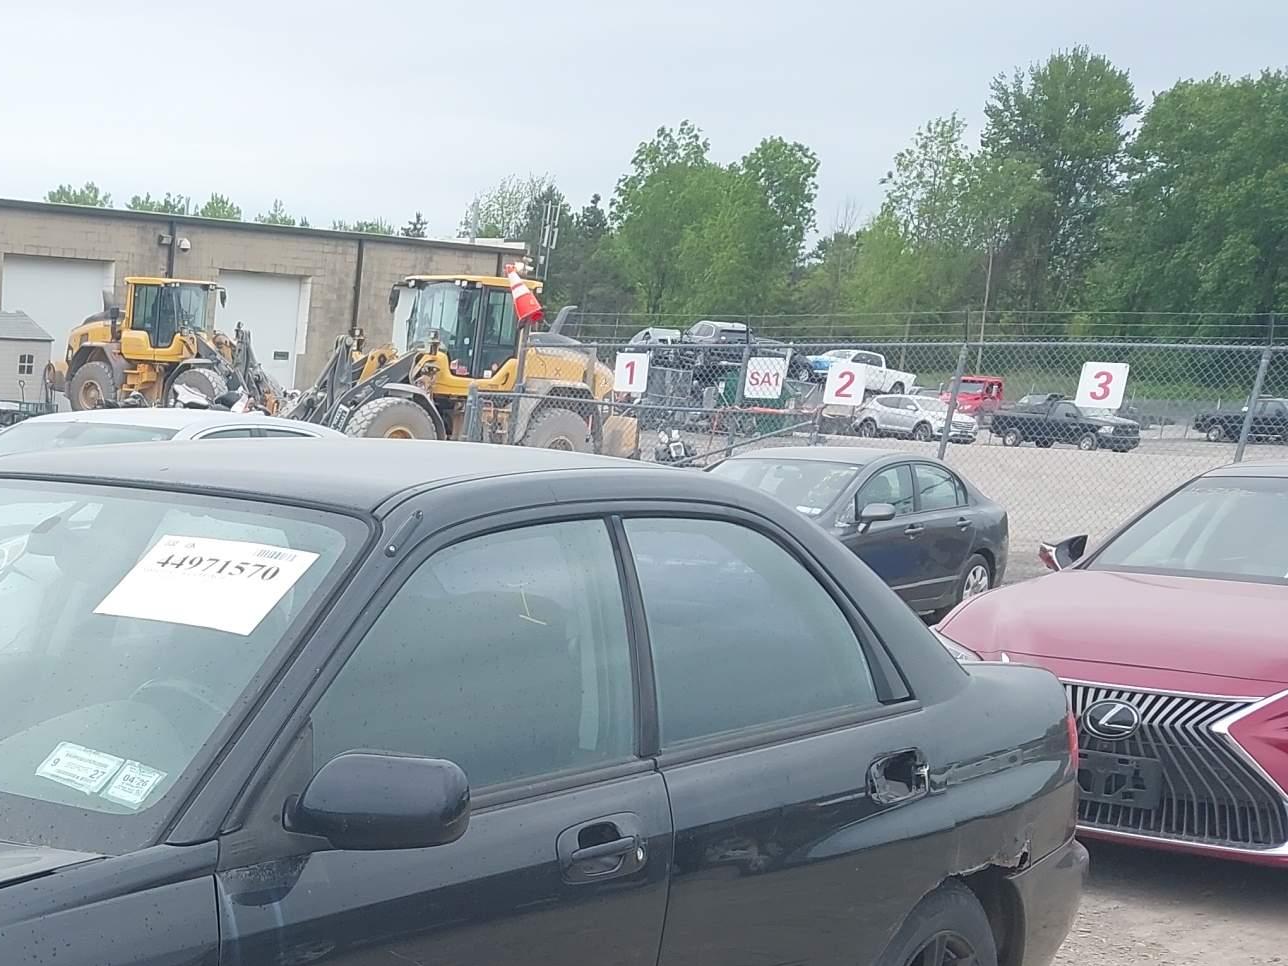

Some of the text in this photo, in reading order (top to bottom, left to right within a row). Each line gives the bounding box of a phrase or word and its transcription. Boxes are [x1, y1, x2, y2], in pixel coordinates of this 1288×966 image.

[624, 360, 636, 386] 1
[748, 371, 781, 387] SA1
[834, 370, 856, 398] 2
[1089, 370, 1114, 401] 3
[156, 554, 280, 581] 44971570
